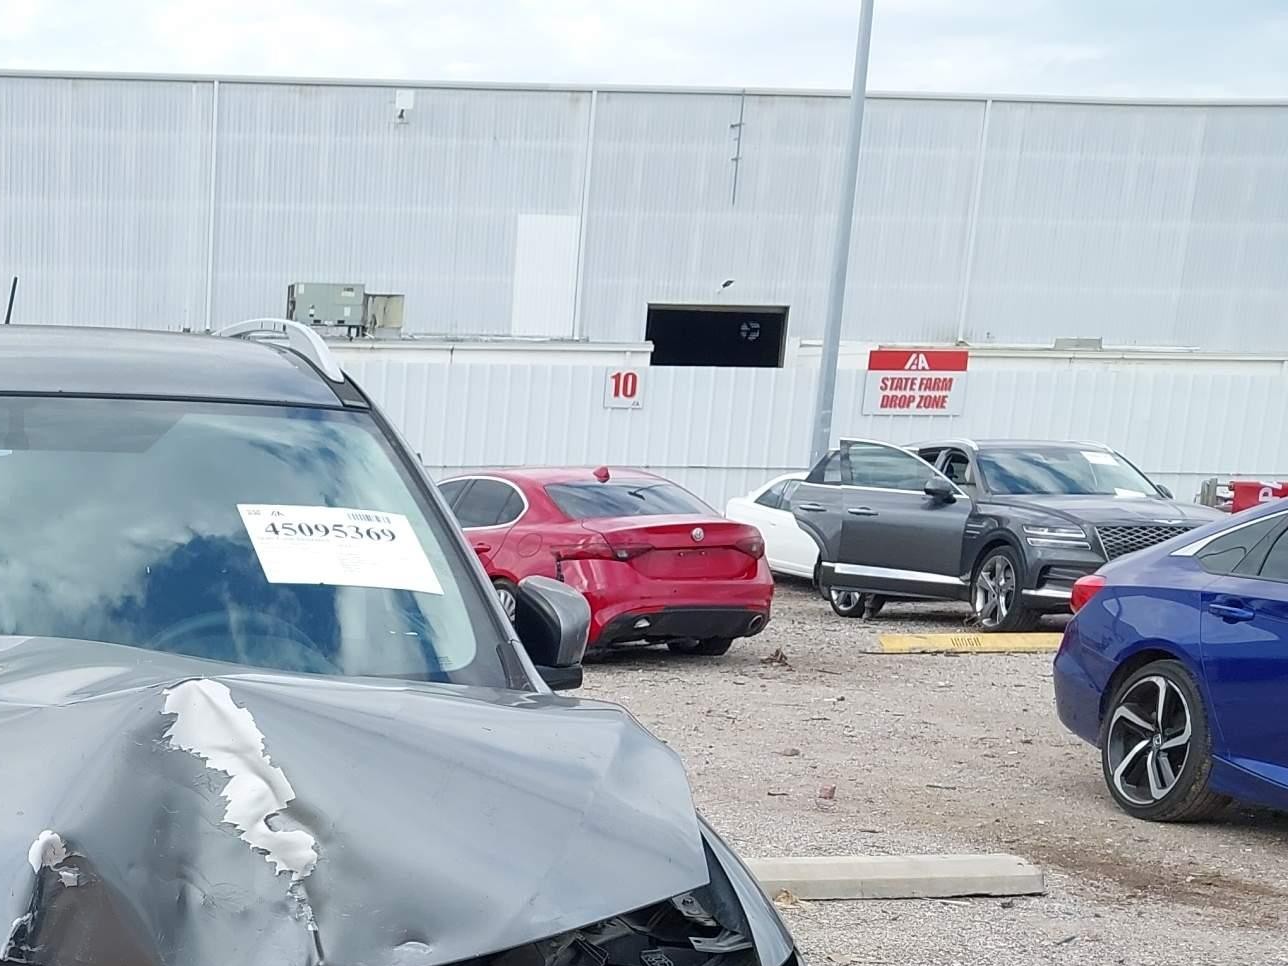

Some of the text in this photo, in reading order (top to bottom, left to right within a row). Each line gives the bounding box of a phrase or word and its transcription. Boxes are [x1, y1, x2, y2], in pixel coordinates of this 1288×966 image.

[611, 372, 638, 398] 10
[880, 377, 954, 391] STATE FARM
[880, 395, 949, 409] DROP ZONE
[264, 521, 397, 543] 45095369
